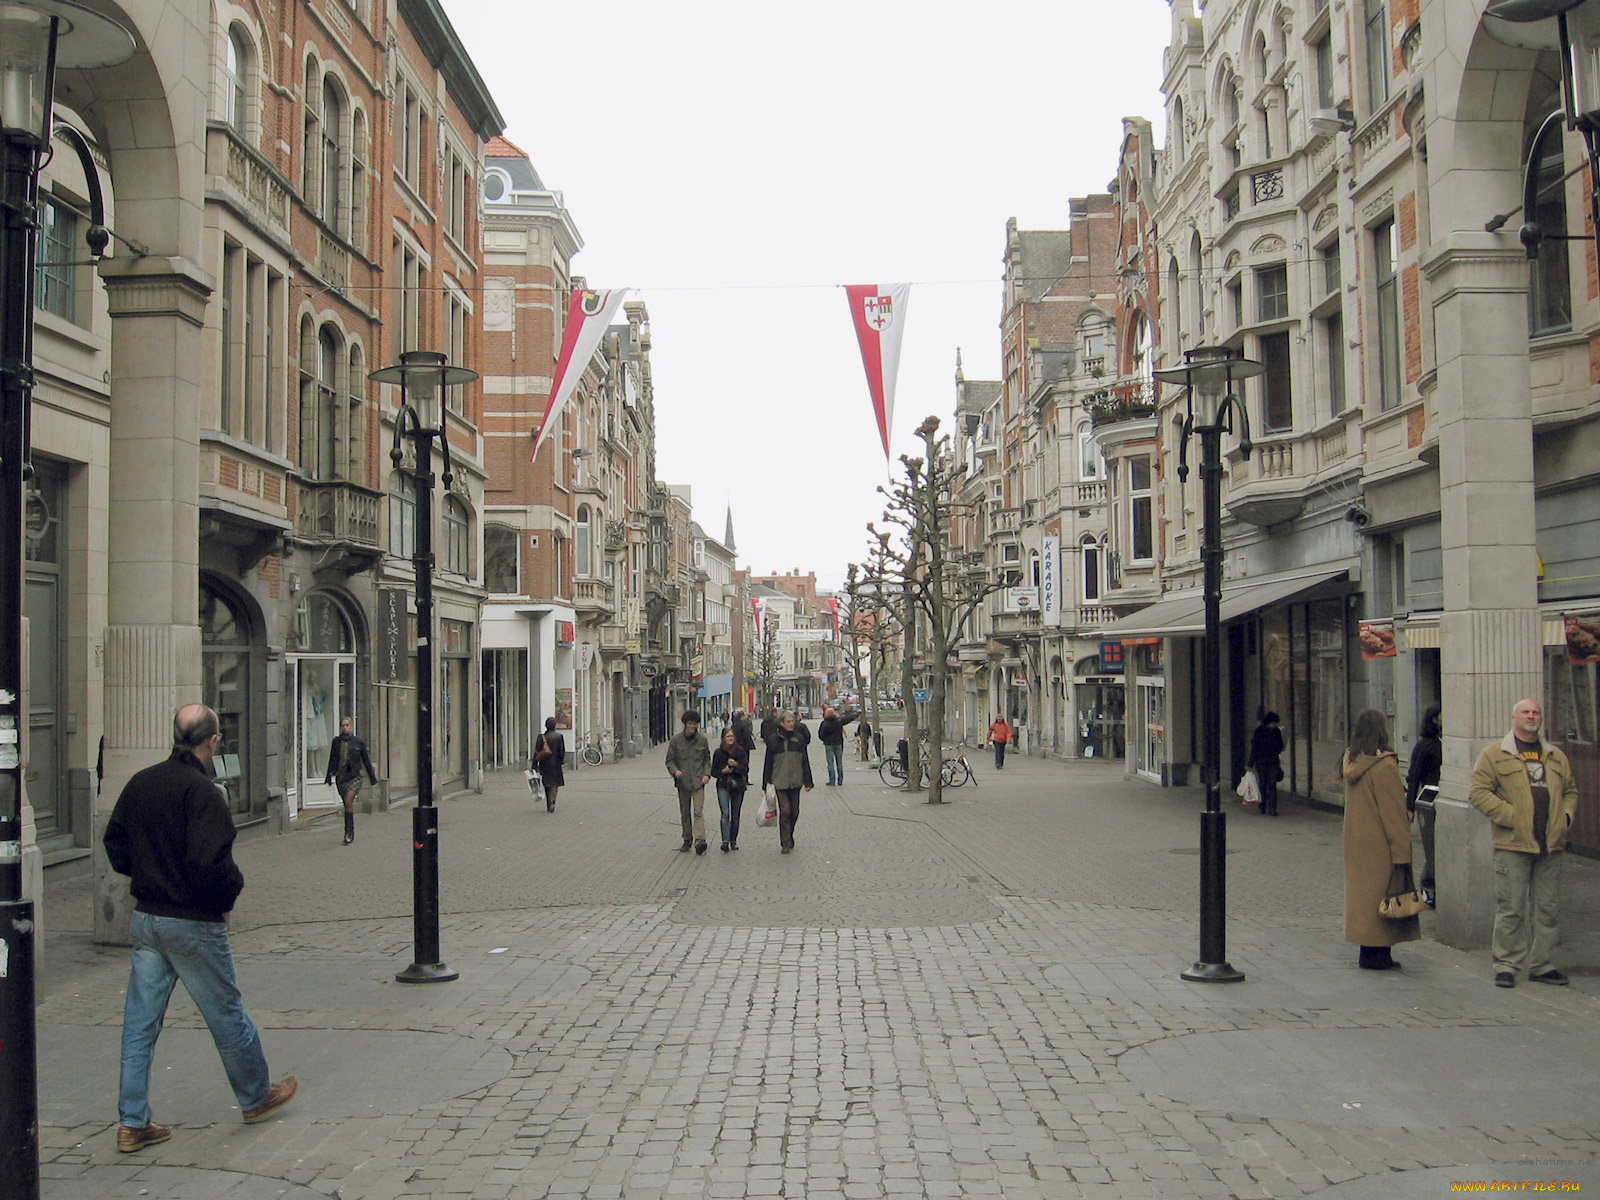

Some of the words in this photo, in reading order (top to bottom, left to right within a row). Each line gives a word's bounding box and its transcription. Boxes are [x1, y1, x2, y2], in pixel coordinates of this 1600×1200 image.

[1044, 540, 1053, 612] KARAOKE
[389, 591, 397, 628] SCAPA
[389, 635, 397, 678] SPORTS
